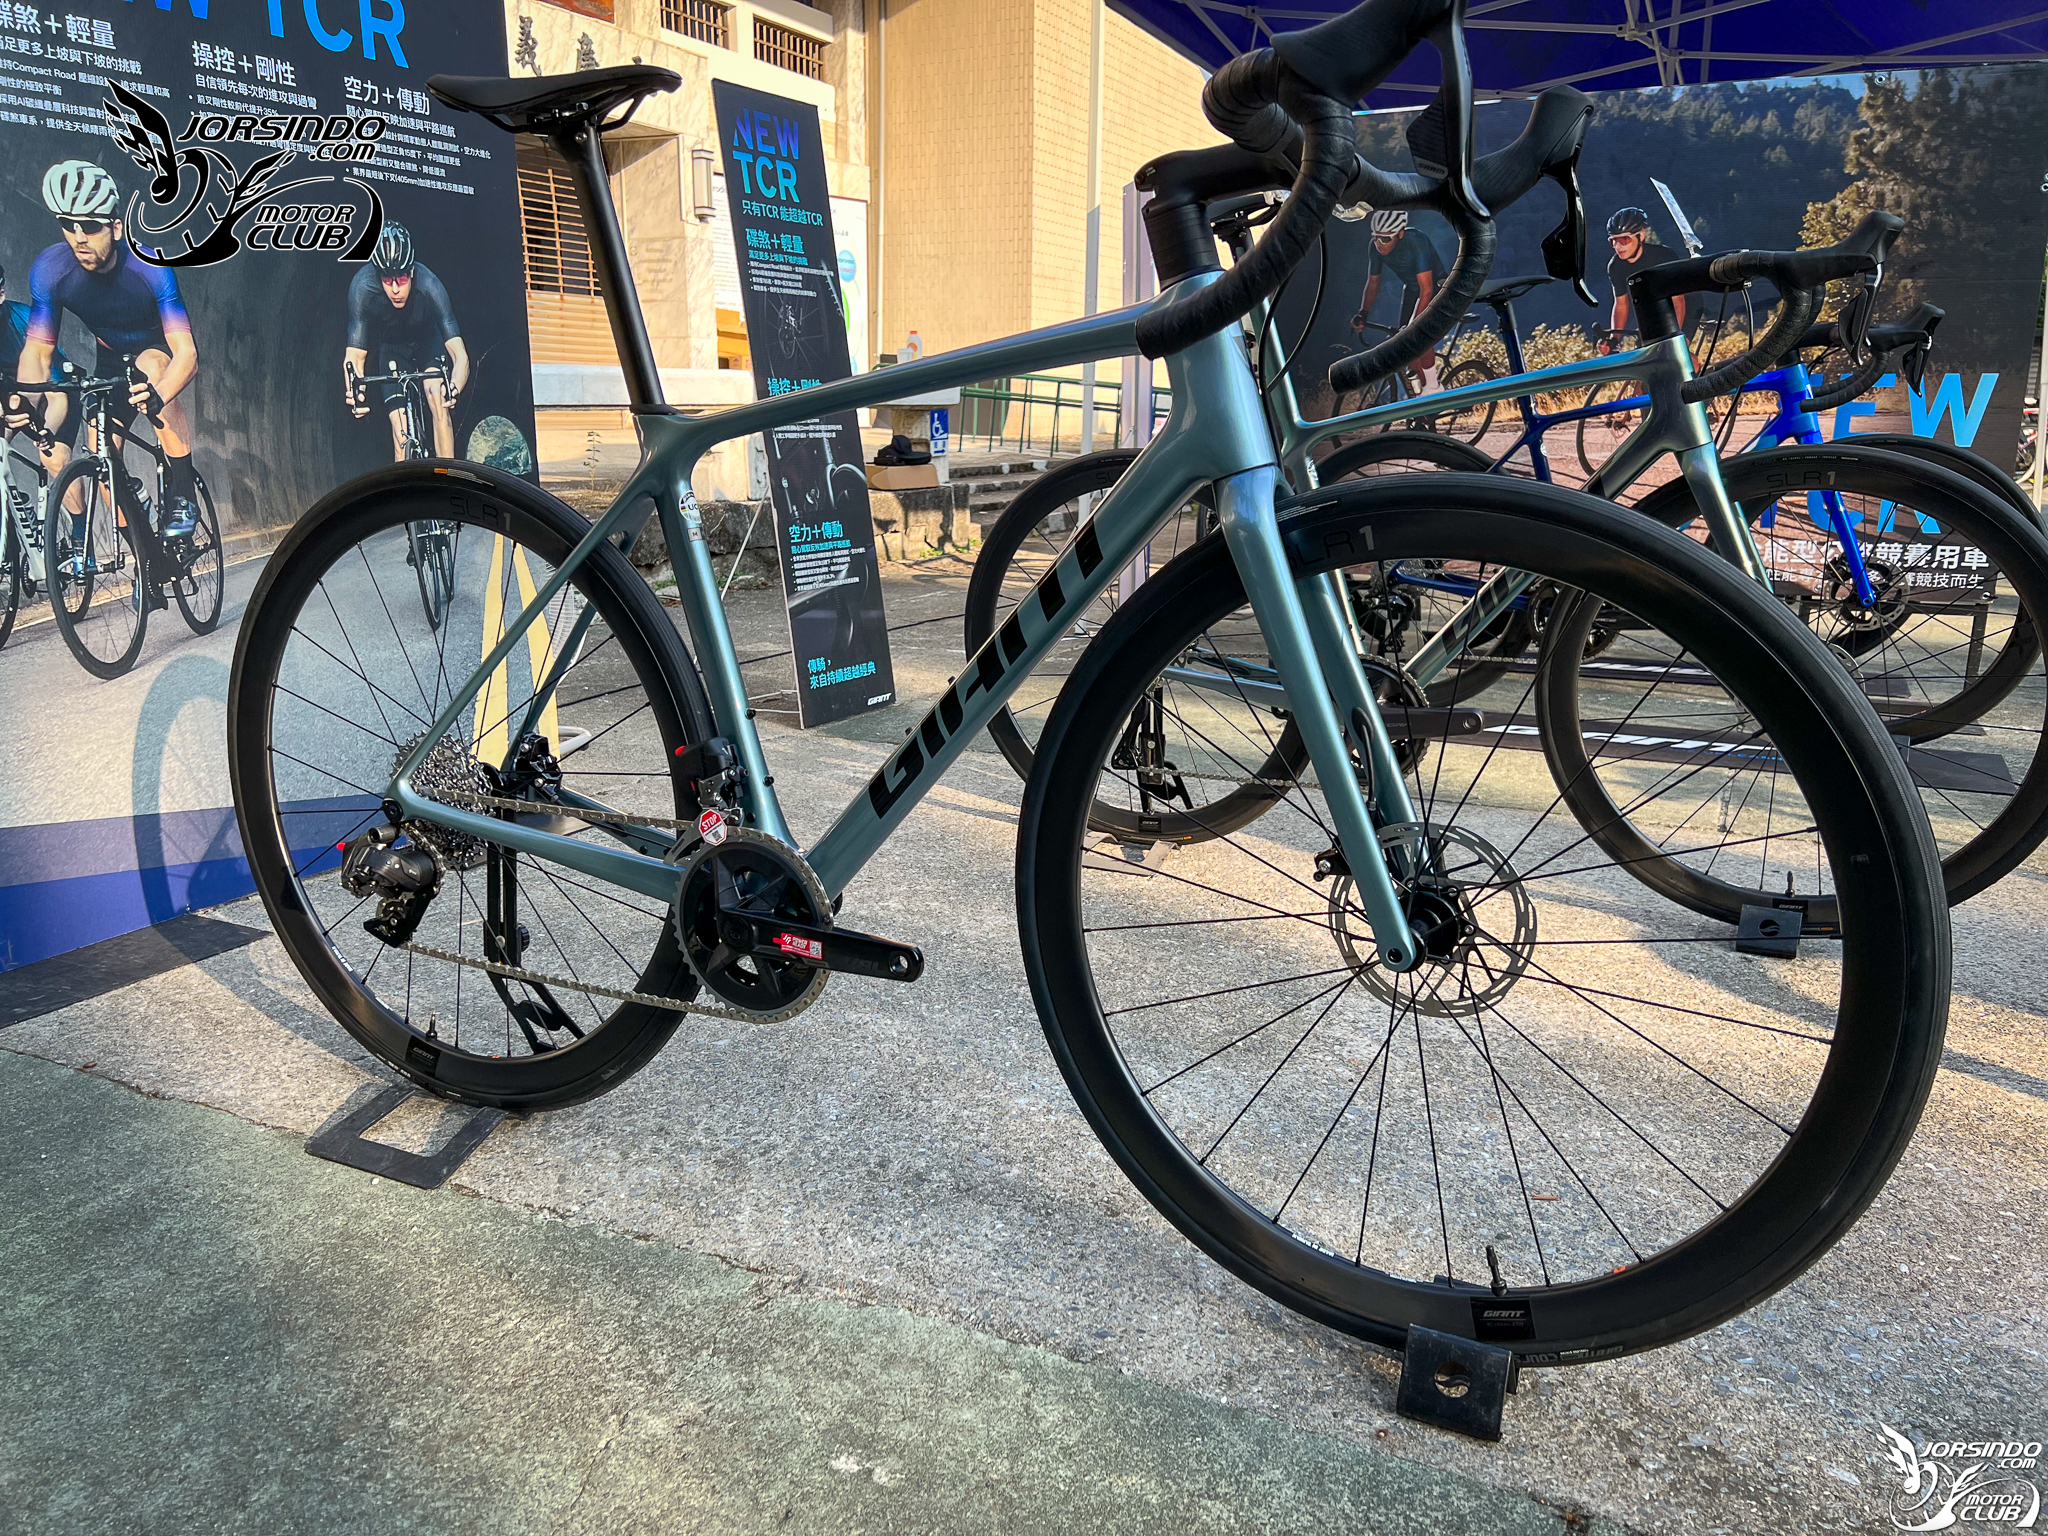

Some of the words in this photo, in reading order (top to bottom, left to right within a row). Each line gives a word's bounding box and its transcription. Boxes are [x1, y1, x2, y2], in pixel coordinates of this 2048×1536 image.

[53, 67, 77, 81] Road
[192, 40, 297, 87] 操控+剛性
[343, 75, 431, 115] 空力+傳動
[733, 107, 799, 160] NEW
[733, 150, 801, 204] TCR
[809, 660, 876, 690] 來自持續超越經典
[868, 514, 1104, 820] GIANT
[867, 692, 892, 706] GIANT
[702, 814, 717, 830] STOP
[1483, 1310, 1525, 1318] GIANT
